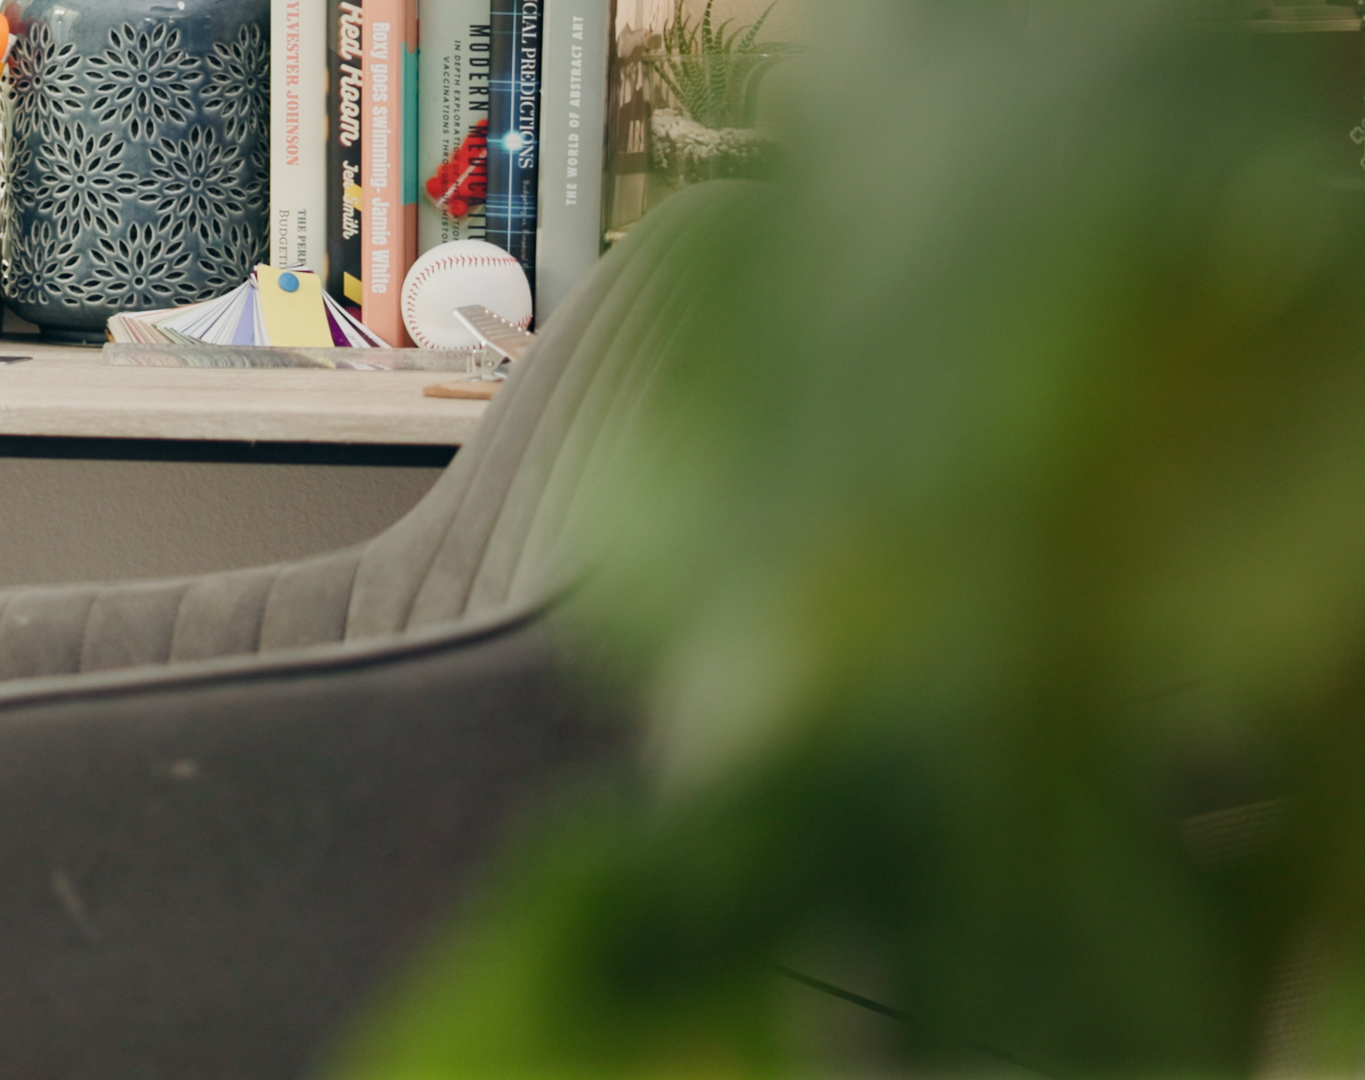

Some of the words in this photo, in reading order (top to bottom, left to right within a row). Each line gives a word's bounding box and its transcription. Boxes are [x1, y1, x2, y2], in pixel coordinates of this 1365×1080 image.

[338, 2, 364, 61] Red
[370, 22, 391, 60] Roxy
[454, 39, 461, 51] IN
[572, 15, 584, 40] ART
[371, 63, 388, 101] goes
[453, 55, 461, 86] DEPTH
[468, 25, 490, 112] MODERN
[570, 44, 583, 108] ABSTRACT
[339, 64, 363, 147] Room
[442, 56, 450, 135] VACCINATIONS
[518, 47, 536, 169] PREDICTIONS
[285, 90, 300, 166] JOHNSON
[452, 89, 461, 160] EXPLORATION
[569, 111, 580, 128] OF
[343, 160, 359, 188] Jen
[567, 133, 579, 178] WORLD
[342, 193, 359, 240] Smith
[566, 182, 578, 206] THE
[297, 209, 307, 232] THE
[371, 197, 391, 246] Jamie
[371, 249, 391, 294] White
